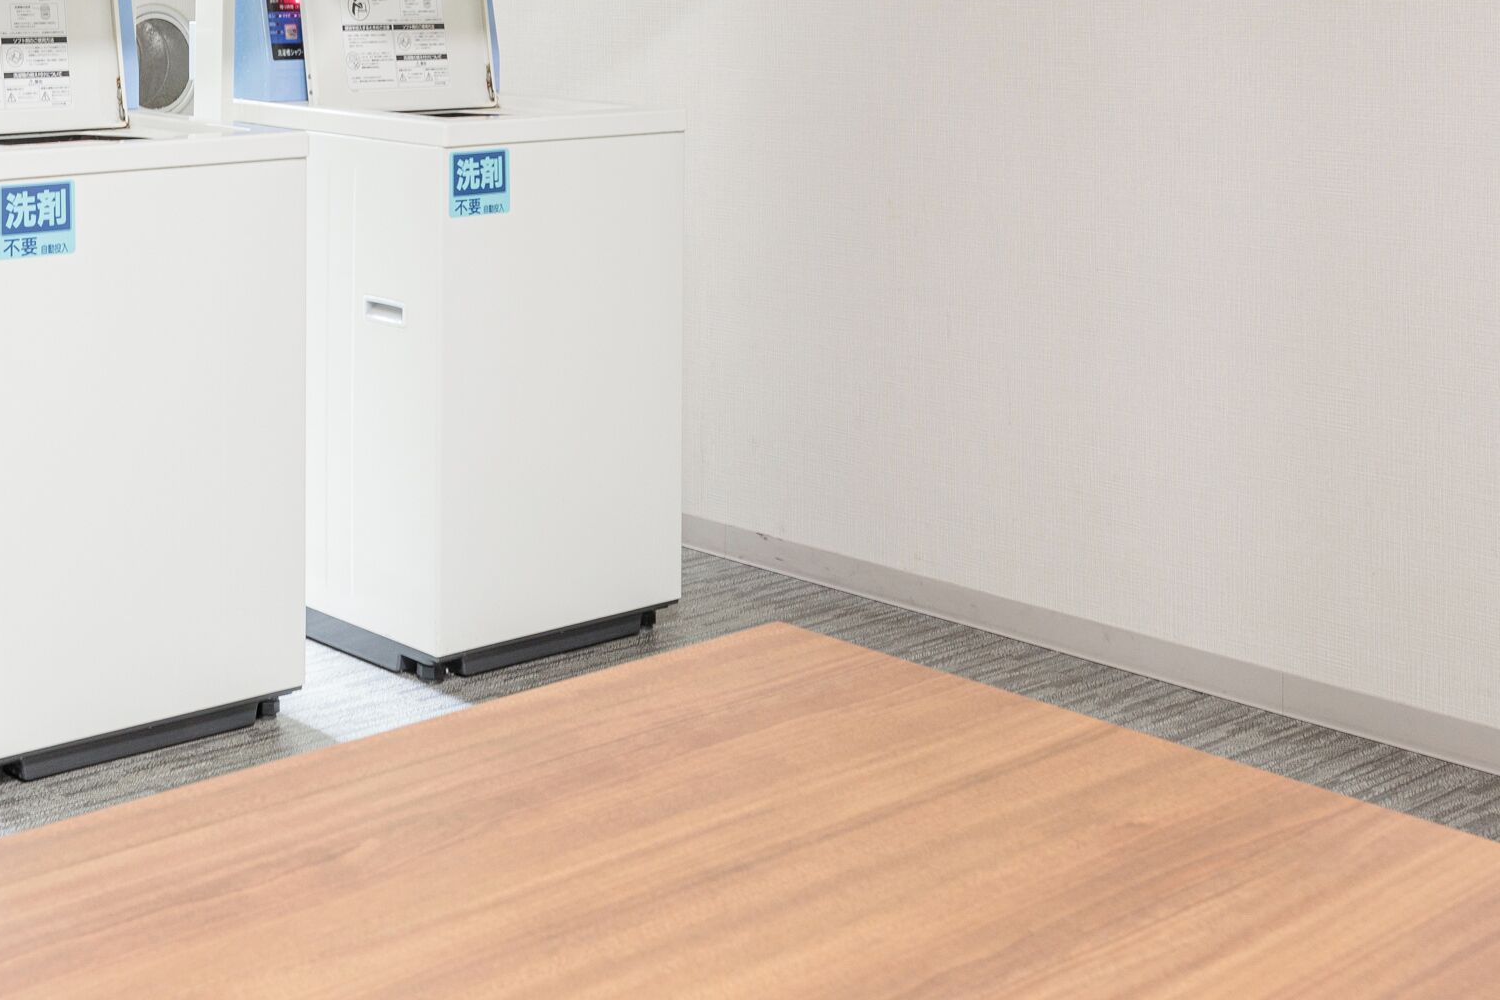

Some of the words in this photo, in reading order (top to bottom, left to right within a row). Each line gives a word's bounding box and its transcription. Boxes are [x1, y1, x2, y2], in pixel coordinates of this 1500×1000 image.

[456, 155, 502, 190] 洗剤
[5, 188, 66, 230] 洗剤
[455, 199, 481, 215] 不要
[483, 203, 504, 214] 自動投入
[4, 237, 37, 258] 不要
[41, 242, 69, 254] 自動投入
